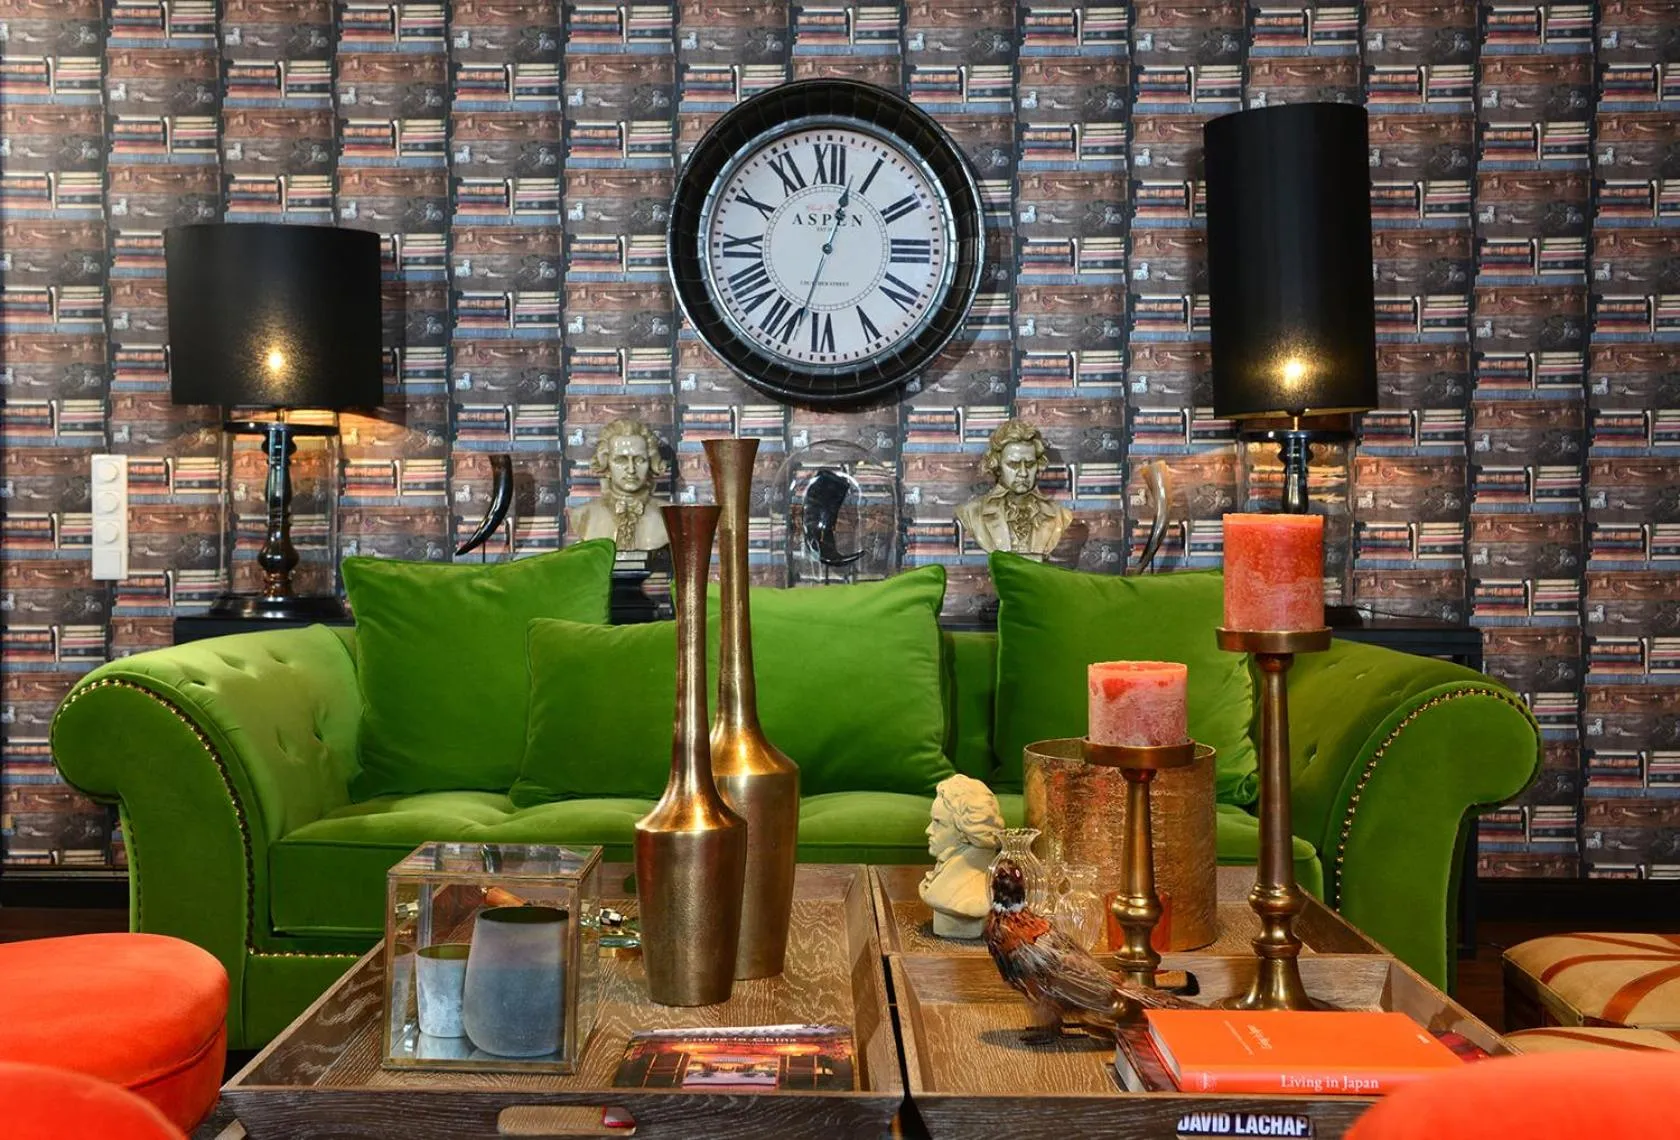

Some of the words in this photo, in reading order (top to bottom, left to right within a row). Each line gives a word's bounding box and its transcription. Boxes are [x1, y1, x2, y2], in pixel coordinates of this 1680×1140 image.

[767, 151, 807, 197] XI
[812, 143, 847, 185] XII
[858, 158, 884, 195] I
[734, 188, 776, 221] X
[792, 212, 863, 227] ASPEN
[880, 193, 922, 224] II
[722, 233, 764, 258] IX
[890, 238, 931, 264] III
[727, 261, 777, 315] VIII
[878, 272, 922, 313] IV
[759, 295, 805, 345] VII
[810, 312, 835, 353] VI
[855, 305, 882, 343] V
[1280, 1074, 1323, 1091] Living
[1326, 1074, 1339, 1088] in
[1343, 1075, 1380, 1091] Japan
[1177, 1112, 1230, 1133] DAVID
